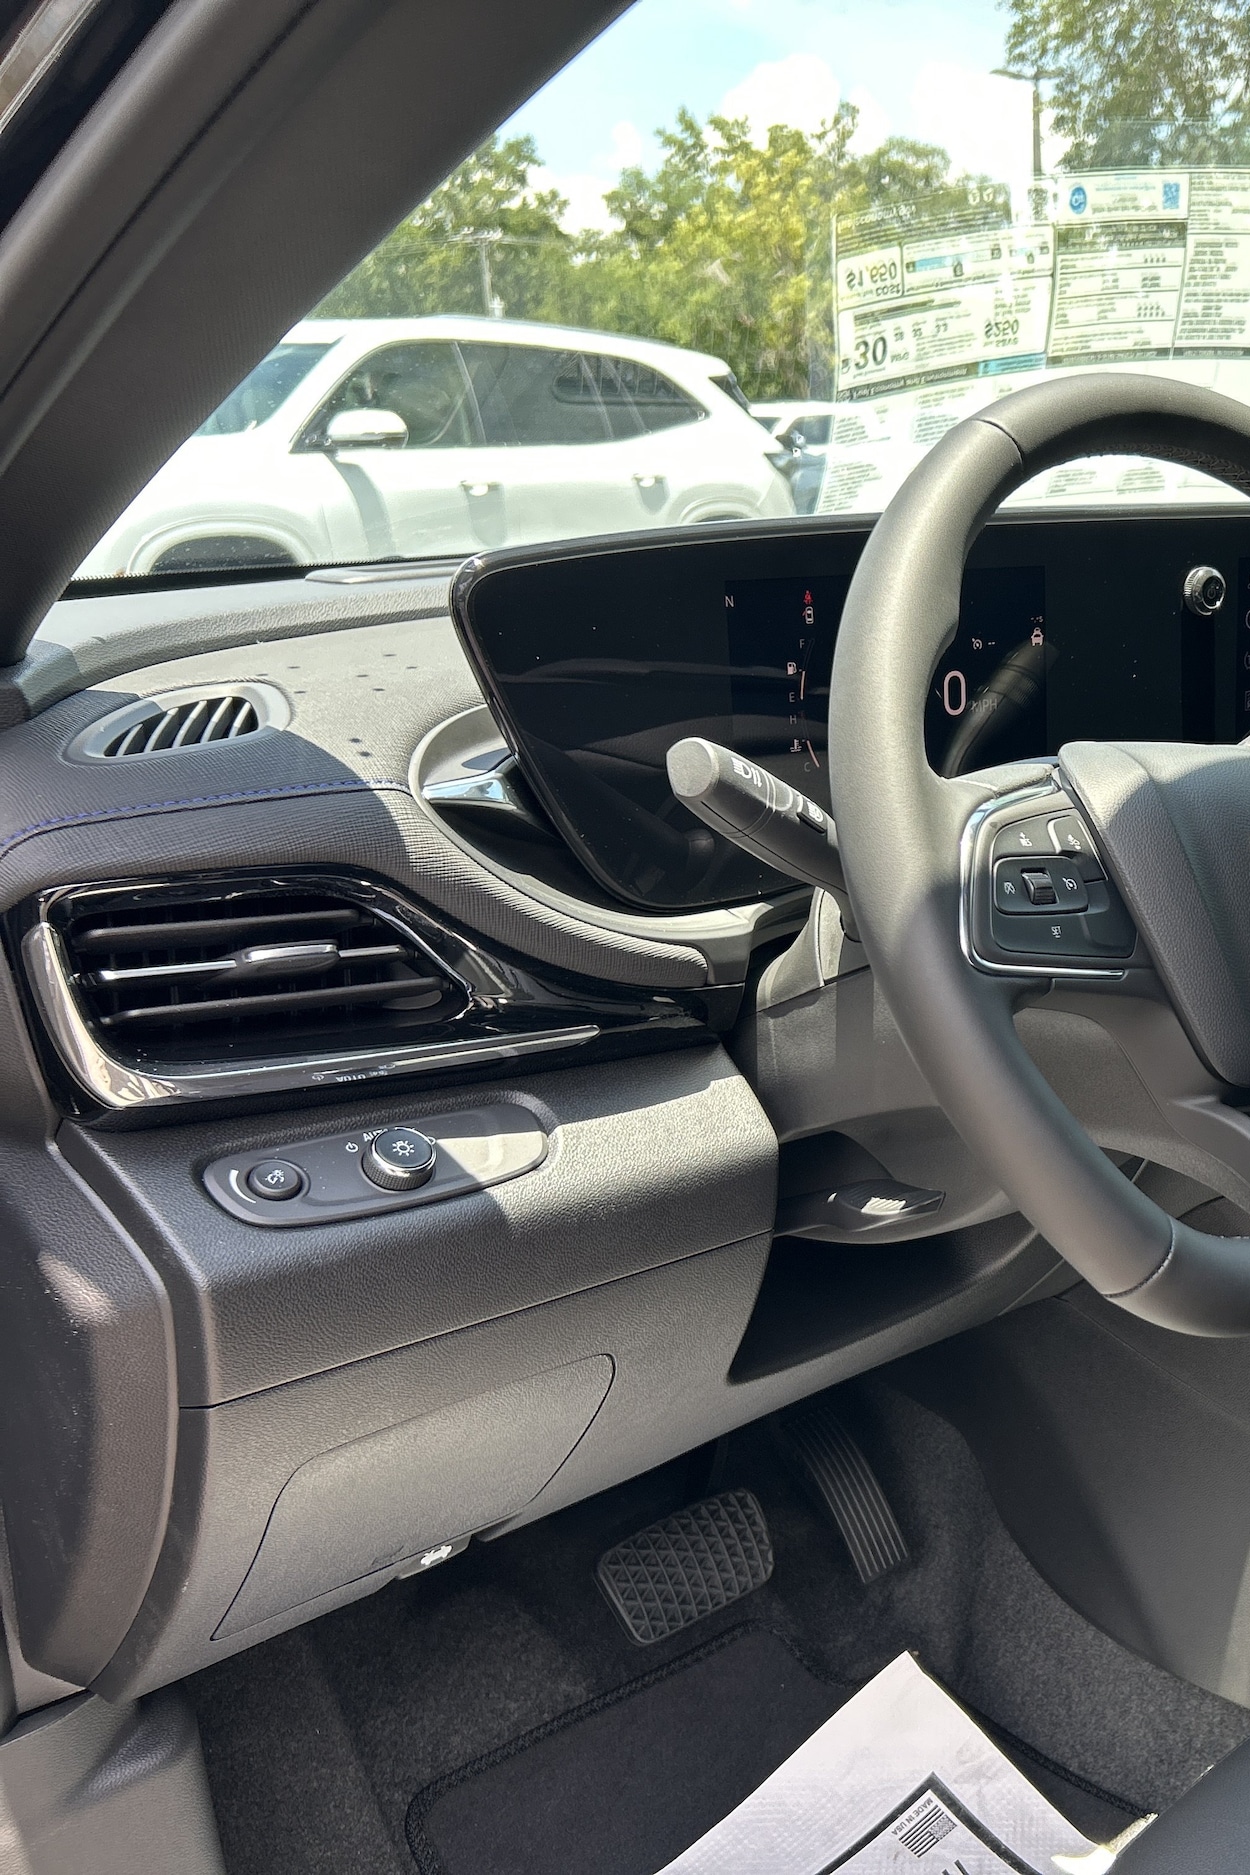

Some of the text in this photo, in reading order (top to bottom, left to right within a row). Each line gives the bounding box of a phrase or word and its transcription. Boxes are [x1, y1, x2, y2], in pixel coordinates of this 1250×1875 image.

[724, 595, 735, 608] N
[799, 638, 806, 649] F
[788, 692, 796, 703] E
[943, 670, 966, 716] 0
[789, 715, 797, 725] H
[803, 761, 811, 773] C
[891, 1797, 934, 1836] MADE IN USA
